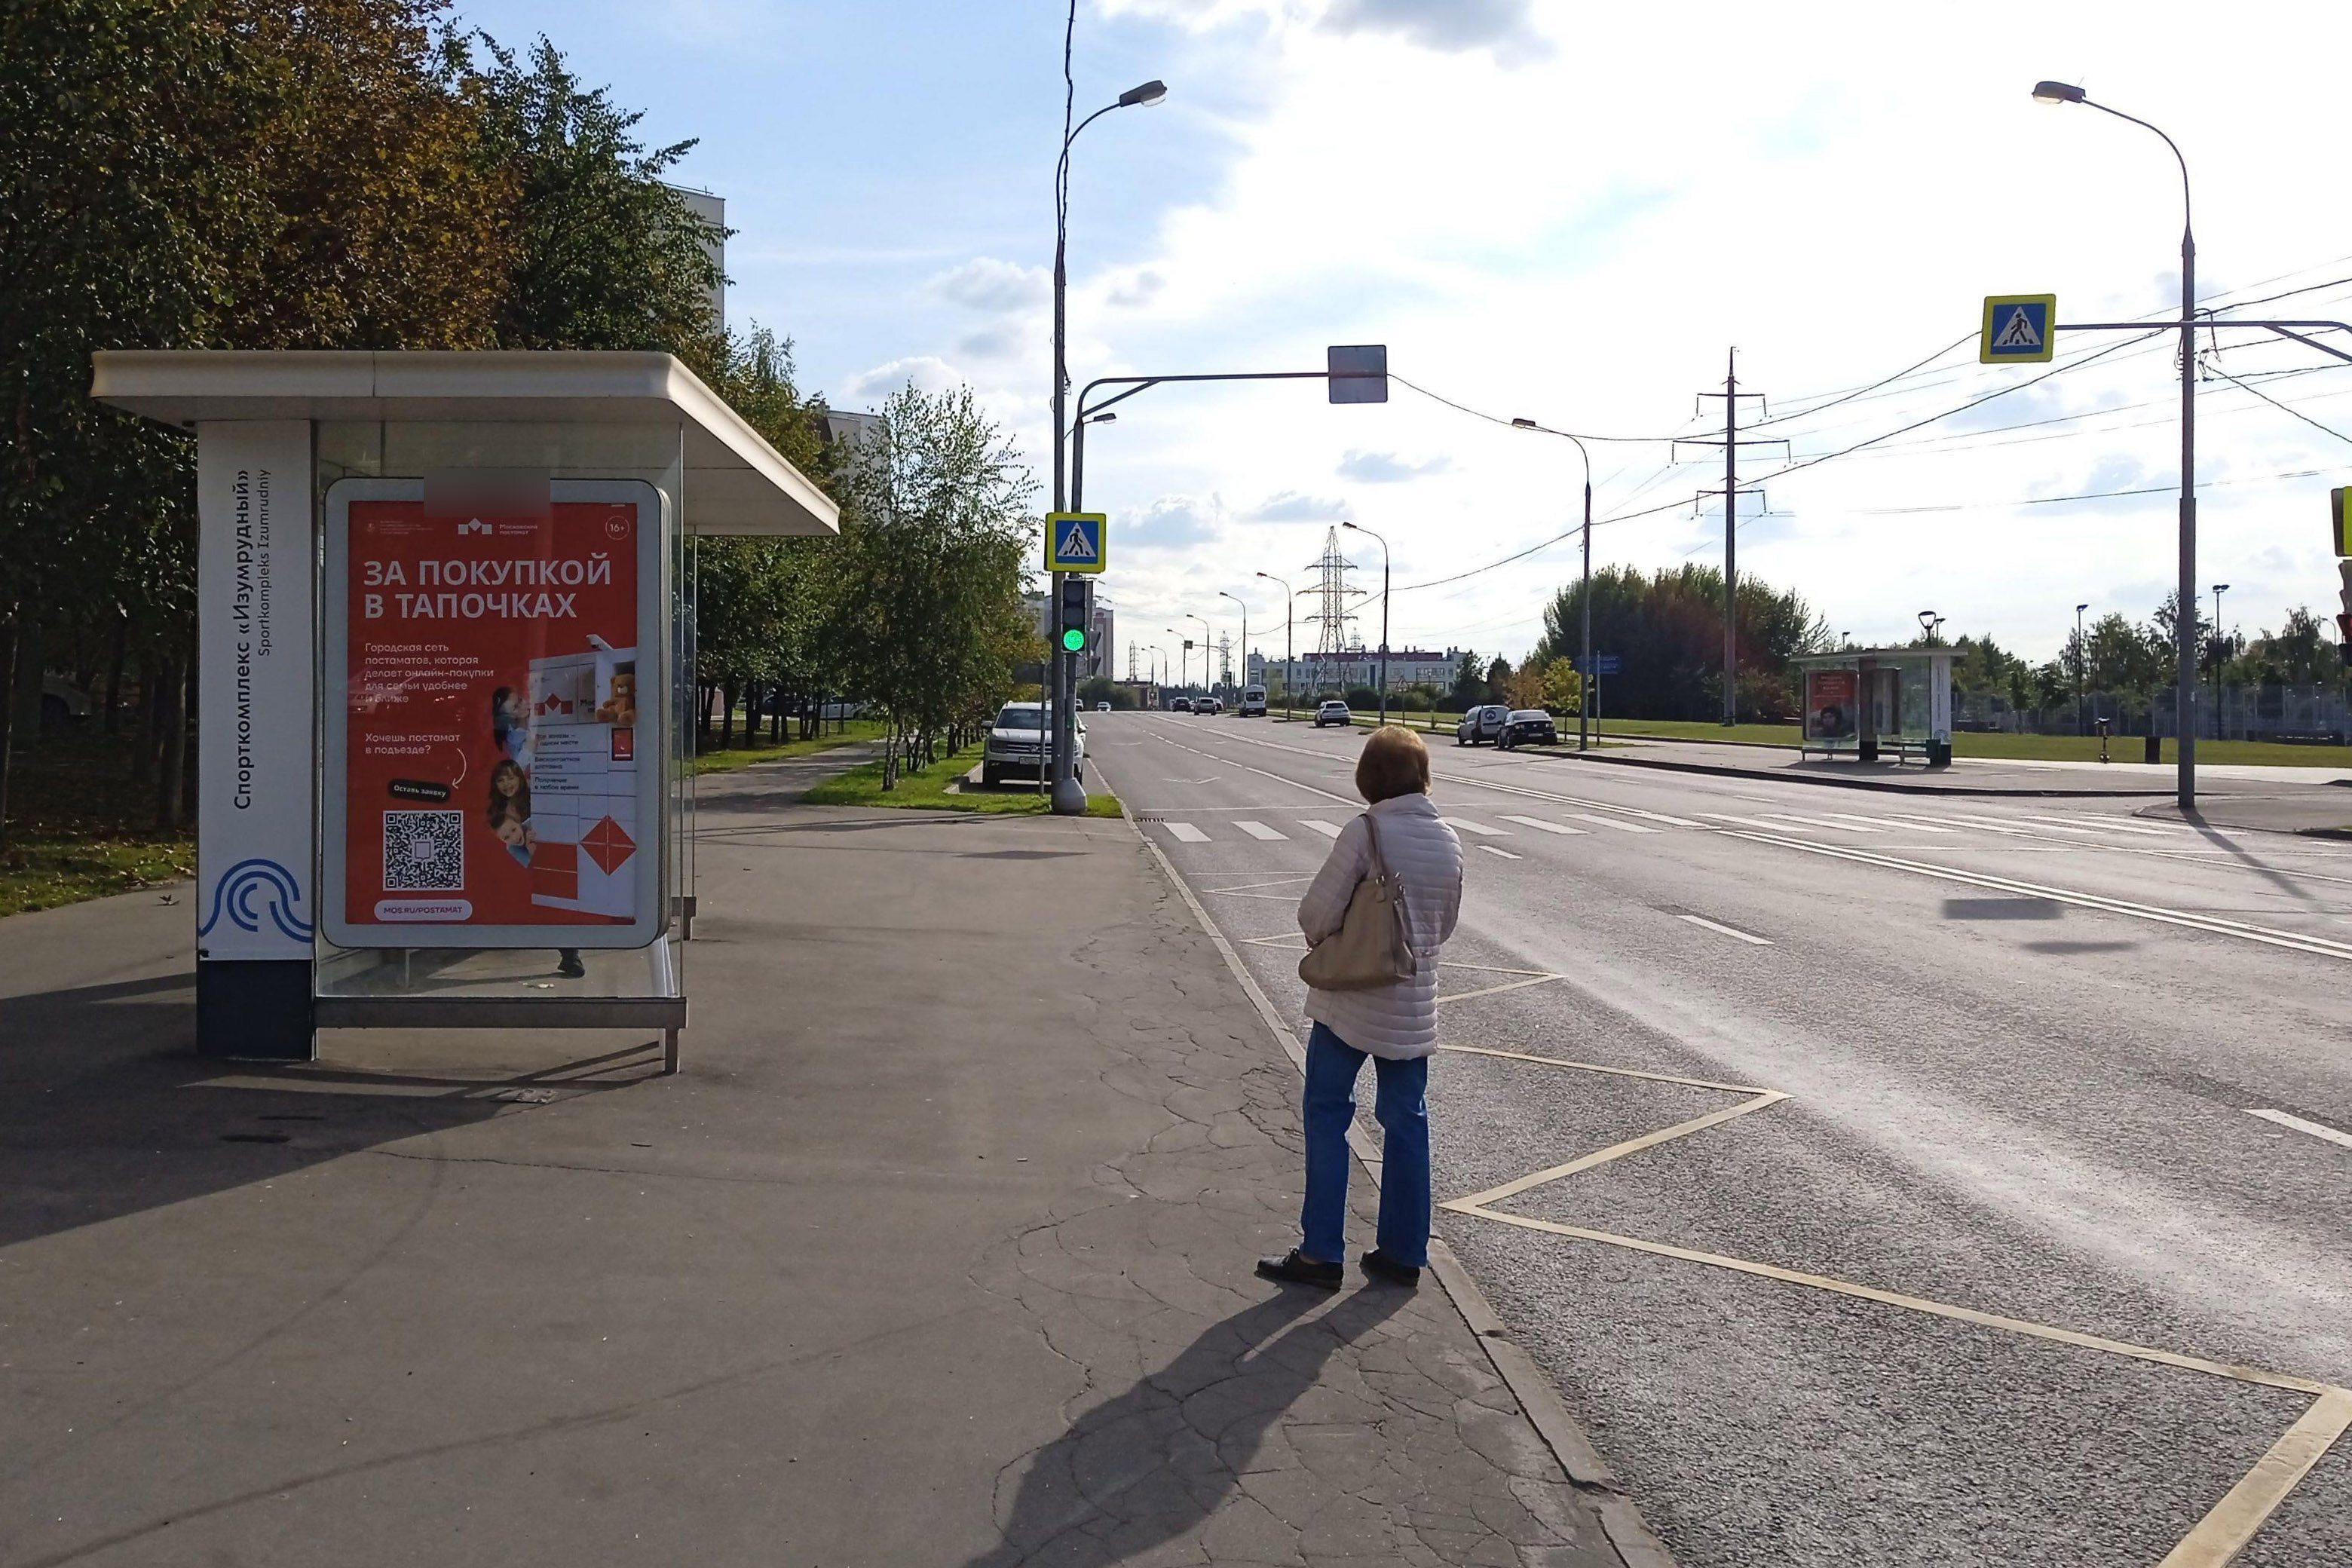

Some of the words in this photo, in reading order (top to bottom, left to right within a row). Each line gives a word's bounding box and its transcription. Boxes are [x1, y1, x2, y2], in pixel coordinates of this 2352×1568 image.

[257, 469, 271, 549] Izumrudniy
[610, 523, 625, 532] 16+
[232, 470, 254, 635] «Изумрудный»
[363, 560, 406, 586] ЗА
[419, 553, 611, 586] ПОКУПКОЙ
[257, 553, 272, 657] Sportkompleks
[365, 593, 384, 619] В
[395, 593, 577, 619] ТАПОЧКАХ
[365, 642, 422, 654] Городская
[365, 657, 432, 665] постаматов,
[434, 657, 479, 666] которая
[365, 670, 403, 678] делает
[405, 668, 495, 678] онлайн-покупки
[365, 682, 384, 691] для
[386, 682, 420, 691] семьи
[422, 681, 468, 691] удобнее
[365, 694, 373, 703] и
[375, 694, 409, 703] ближе
[234, 642, 255, 810] Спорткомплекс
[365, 733, 406, 743] Хочешь
[409, 734, 461, 743] постамат
[375, 745, 431, 755] подъезде?
[394, 785, 420, 794] Оставь
[421, 789, 447, 798] заявку
